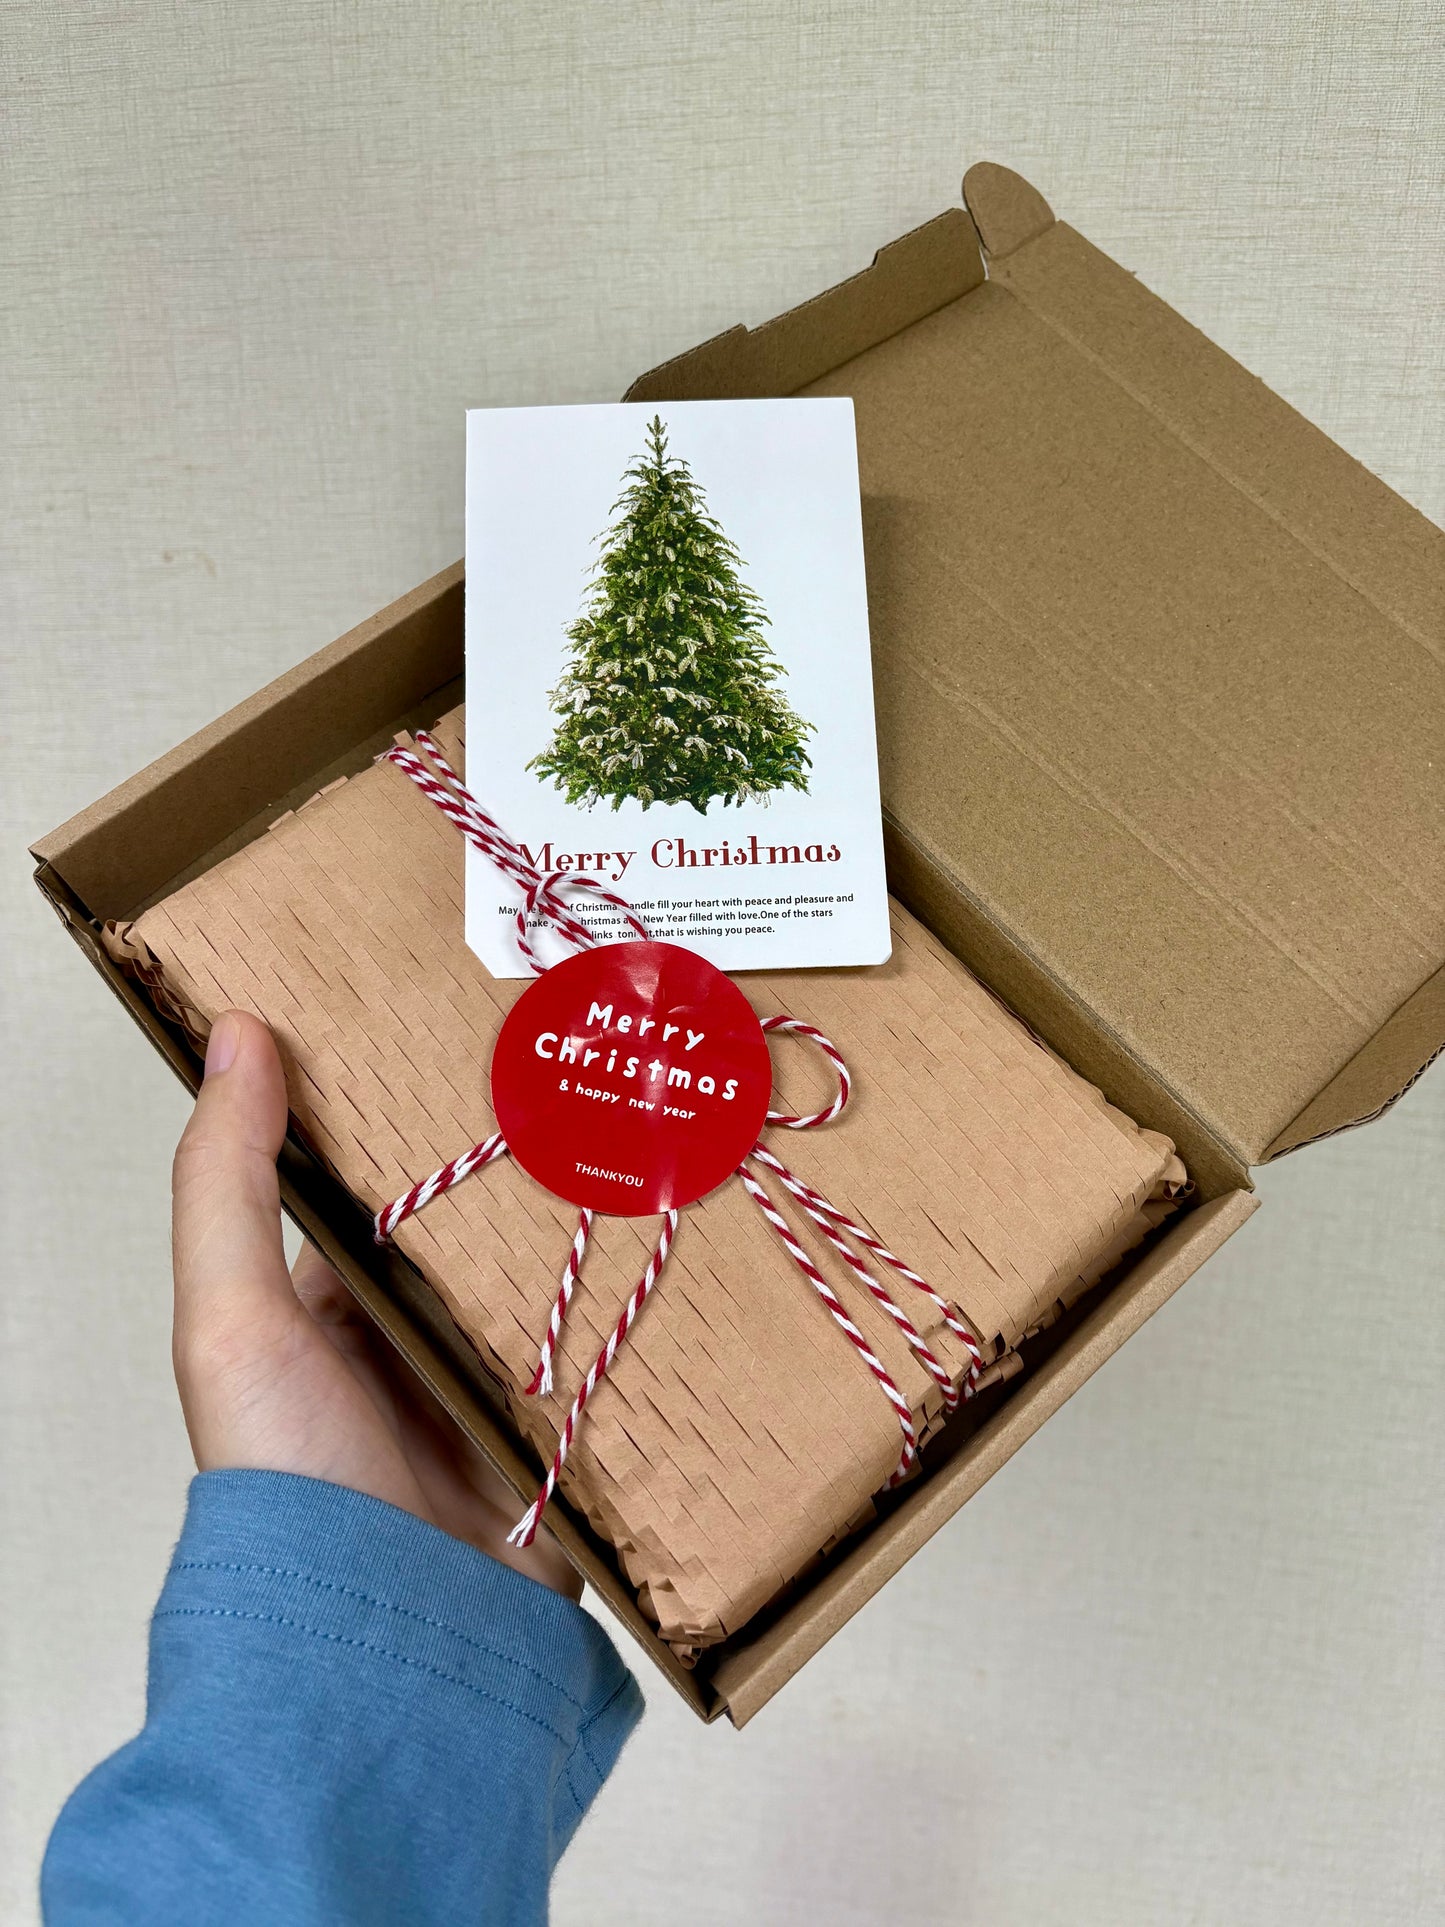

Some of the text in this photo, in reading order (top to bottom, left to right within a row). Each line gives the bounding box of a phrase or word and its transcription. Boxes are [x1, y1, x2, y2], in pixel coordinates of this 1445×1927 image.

[516, 835, 841, 881] Merry Christmas
[498, 905, 518, 916] May
[576, 902, 620, 912] Christma
[628, 901, 655, 910] andle
[657, 900, 669, 909] fill
[671, 901, 693, 910] your
[695, 898, 720, 907] heart
[722, 897, 743, 907] with
[745, 897, 772, 907] peace
[774, 896, 792, 905] and
[794, 894, 834, 905] pleasure
[836, 893, 854, 902] and
[578, 917, 621, 925] hristmas
[643, 914, 664, 923] New
[666, 913, 686, 922] Year
[689, 912, 713, 922] filled
[715, 911, 736, 921] with
[781, 909, 791, 918] of
[793, 909, 809, 918] the
[811, 908, 833, 917] stars
[592, 930, 613, 940] links
[676, 927, 684, 936] is
[686, 926, 723, 936] wishing
[724, 926, 743, 936] you
[744, 925, 776, 935] peace.
[586, 1001, 705, 1051] Merry
[534, 1032, 739, 1101] Christmas
[558, 1078, 696, 1120] & happy new year
[575, 1162, 644, 1188] THANKYOU
